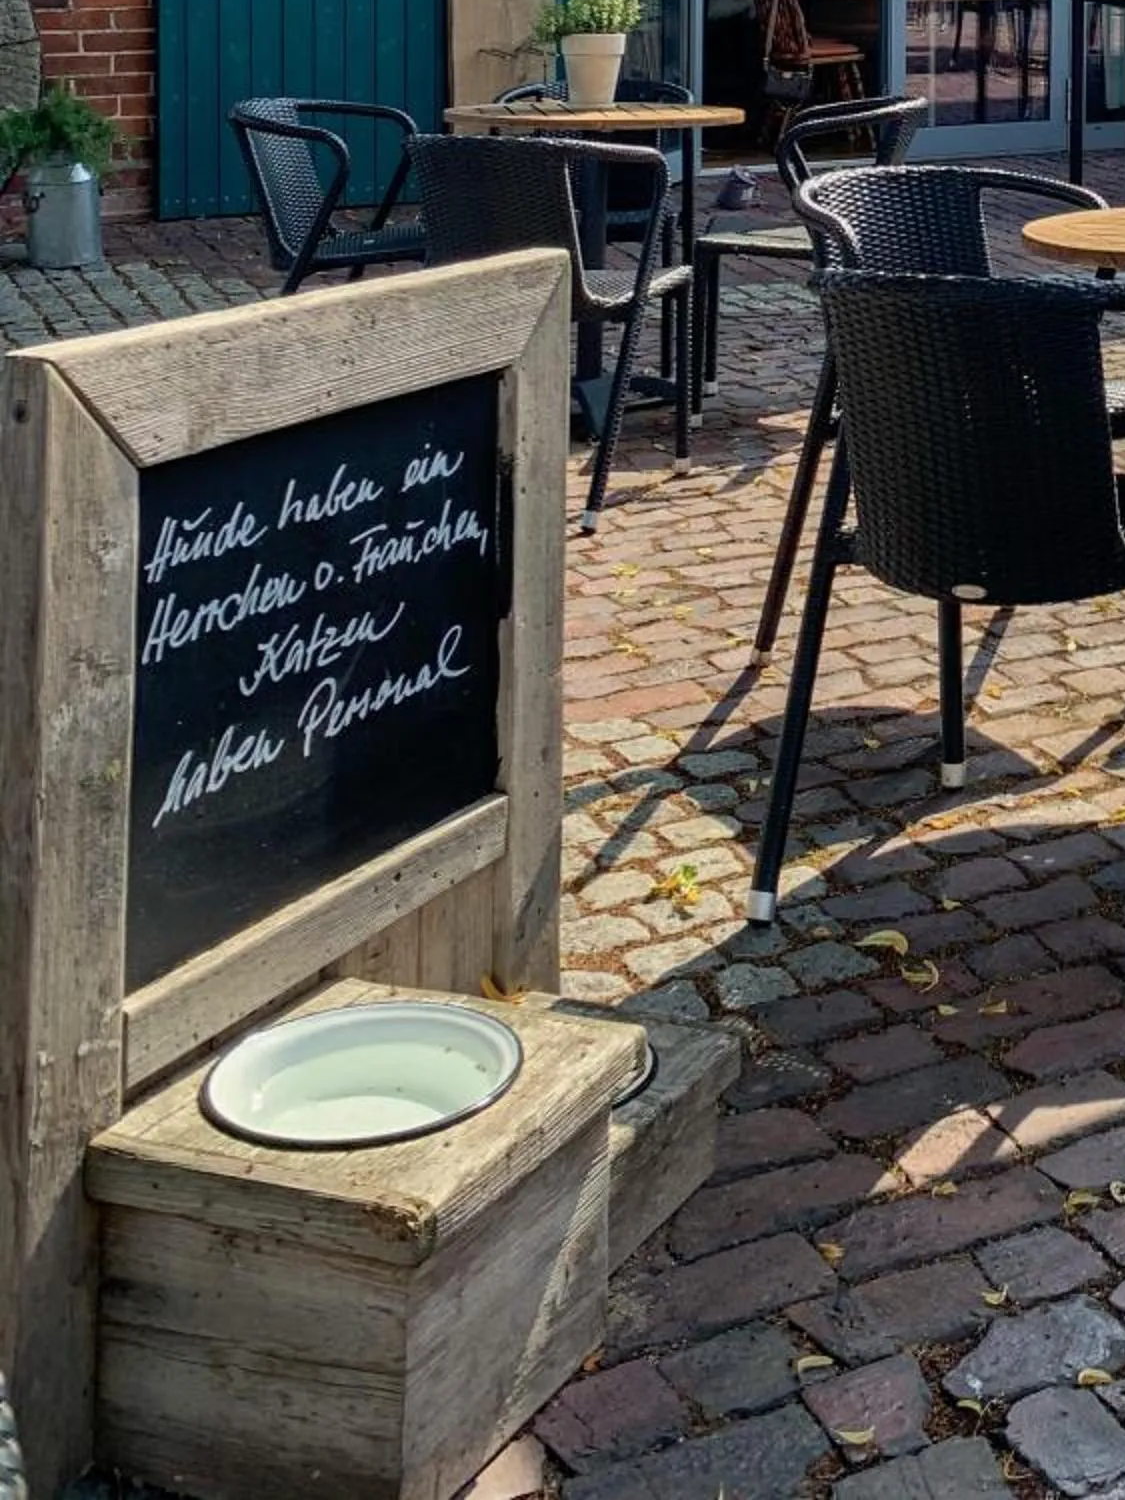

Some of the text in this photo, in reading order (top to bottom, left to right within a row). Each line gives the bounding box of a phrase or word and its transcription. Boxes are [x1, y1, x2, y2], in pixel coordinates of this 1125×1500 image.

[278, 463, 384, 531] haben
[400, 443, 465, 493] ein
[142, 564, 306, 664] Herrchen
[315, 561, 343, 590] o.
[240, 602, 405, 697] Katzen
[152, 624, 471, 827] haben Personal
